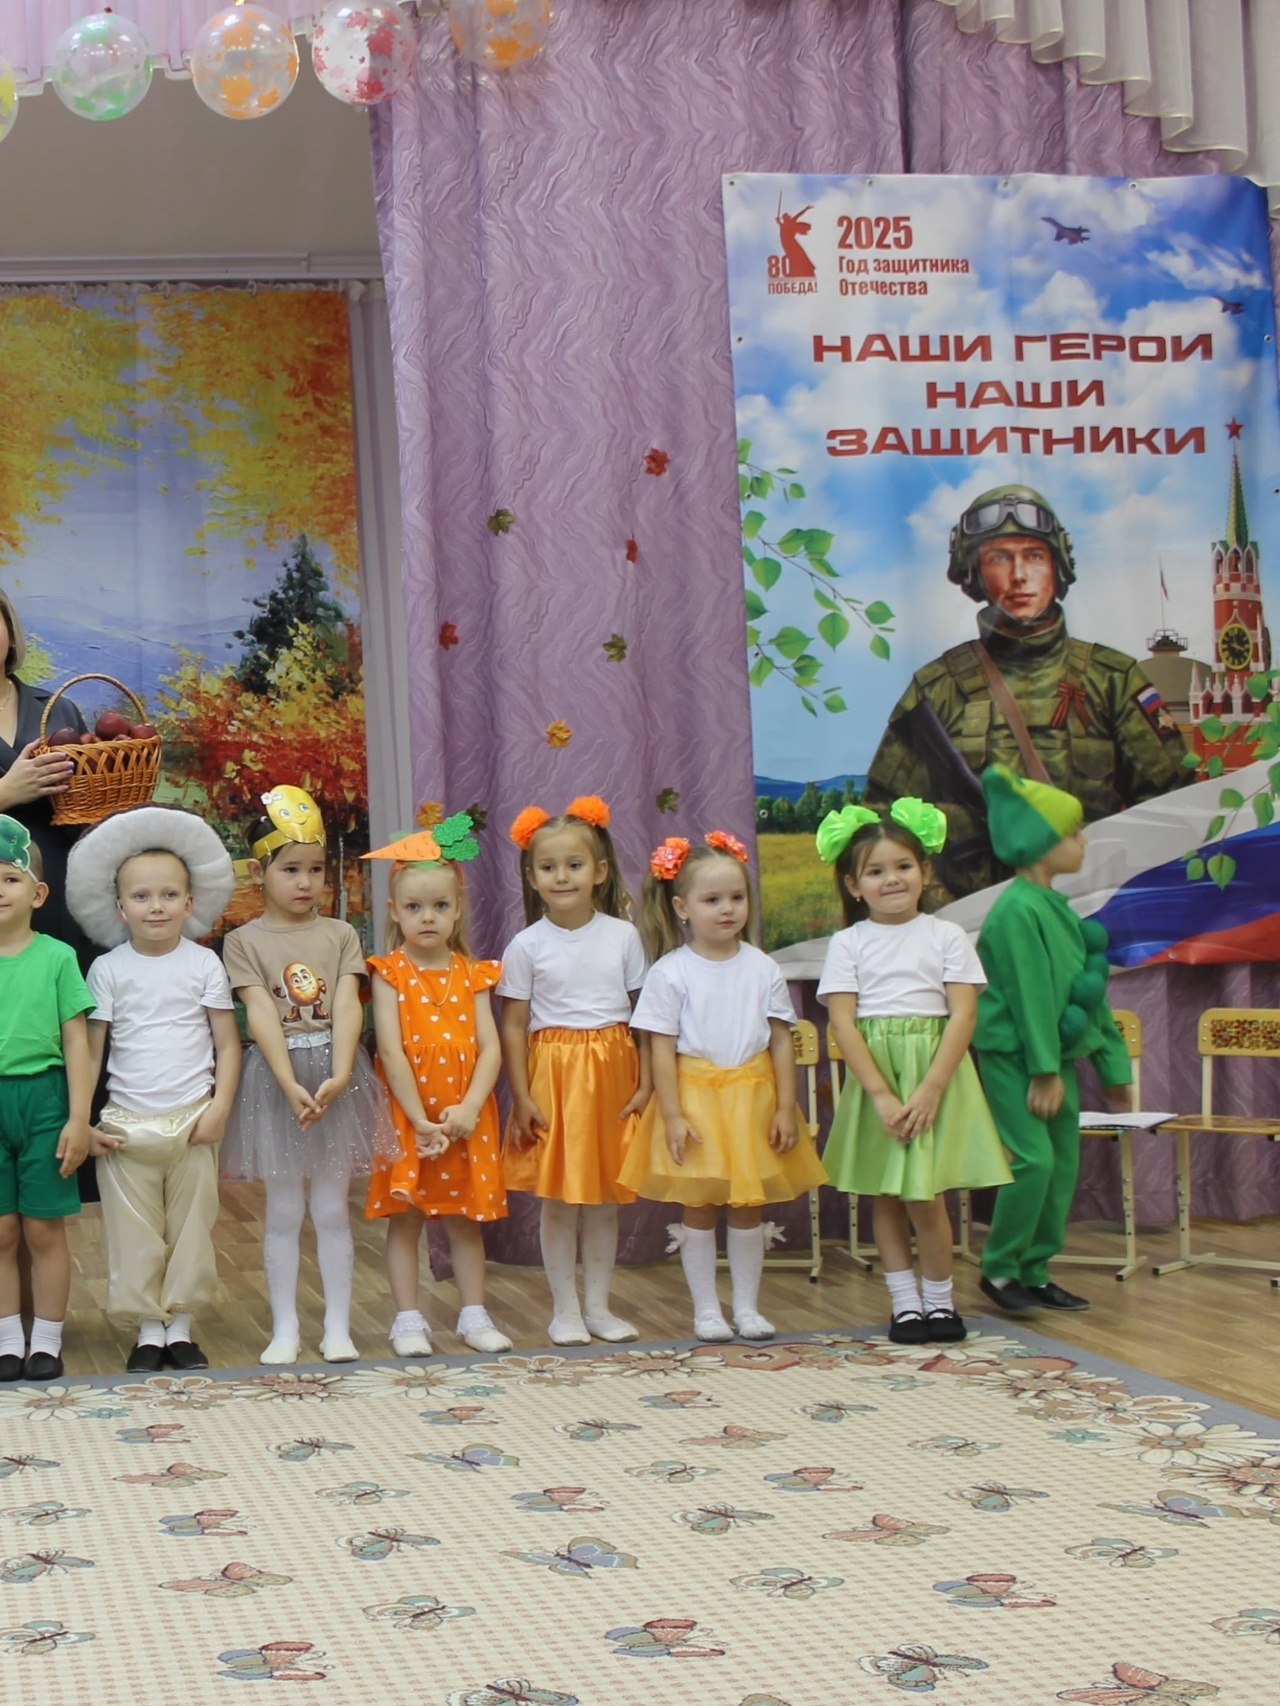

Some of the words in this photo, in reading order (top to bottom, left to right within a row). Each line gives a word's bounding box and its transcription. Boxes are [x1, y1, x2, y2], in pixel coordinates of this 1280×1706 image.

[837, 215, 913, 250] 2025
[838, 256, 870, 274] Год
[873, 257, 970, 276] защитника
[767, 280, 818, 295] ПОБЕДА!
[839, 279, 928, 296] Отечества
[812, 333, 993, 364] НАШИ
[1012, 332, 1214, 363] ГЕРОИ
[926, 379, 1106, 411] НАШИ
[825, 426, 1207, 458] ЗАЩИТНИКИ
